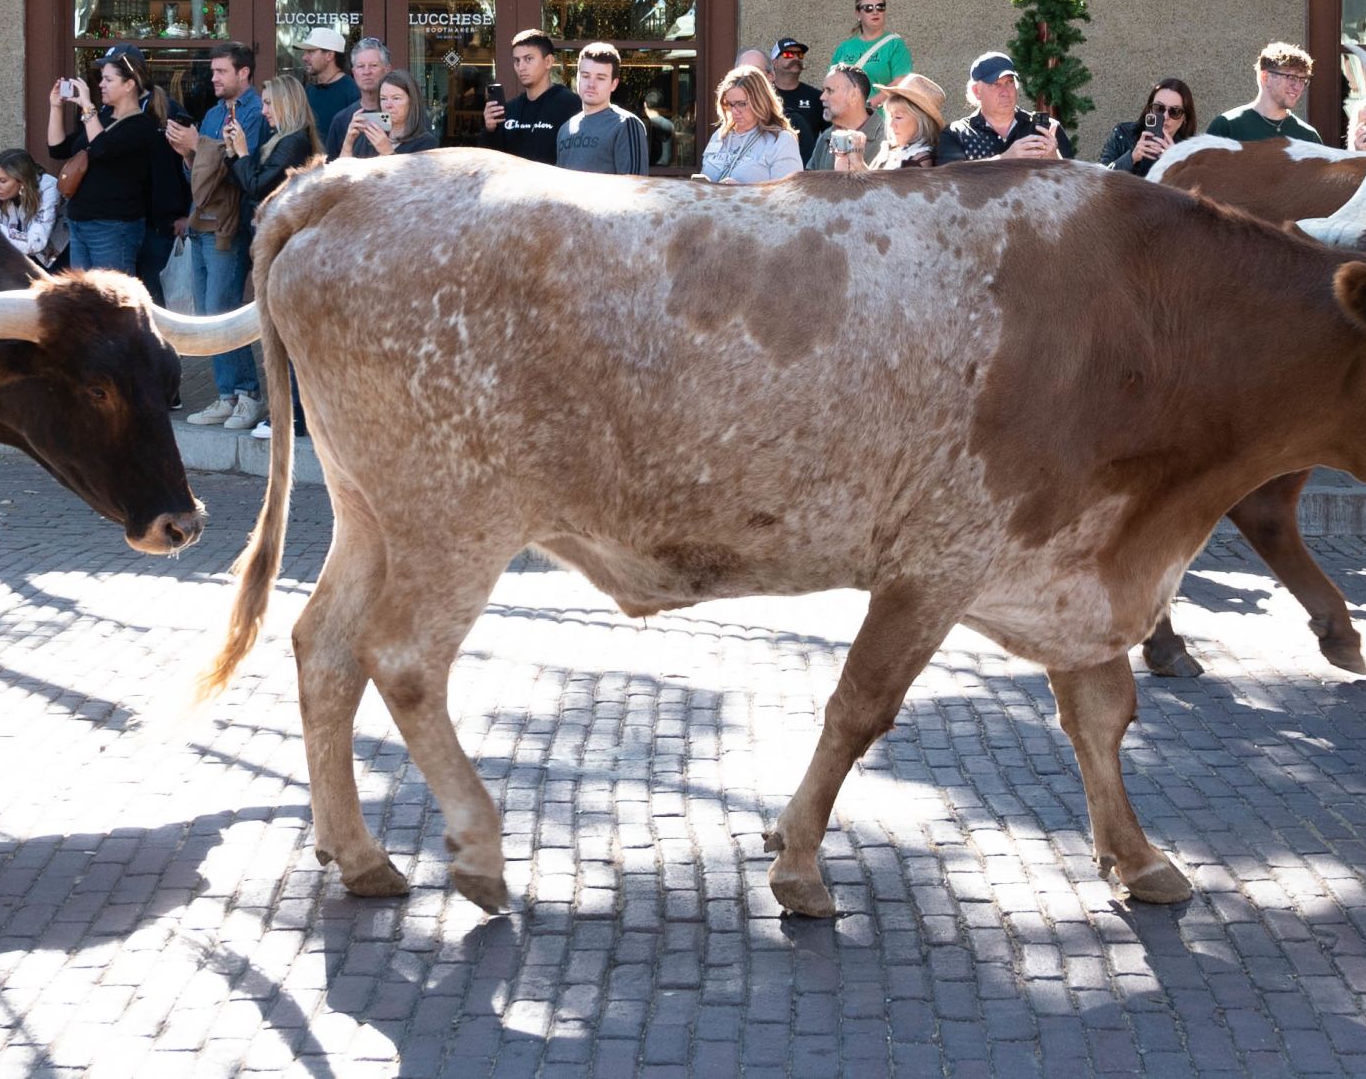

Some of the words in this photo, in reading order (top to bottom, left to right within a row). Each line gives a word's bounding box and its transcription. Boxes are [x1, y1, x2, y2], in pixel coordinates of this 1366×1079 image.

[275, 13, 360, 24] LUCCHESE
[408, 13, 492, 25] LUCCHESE
[558, 133, 599, 152] adidas
